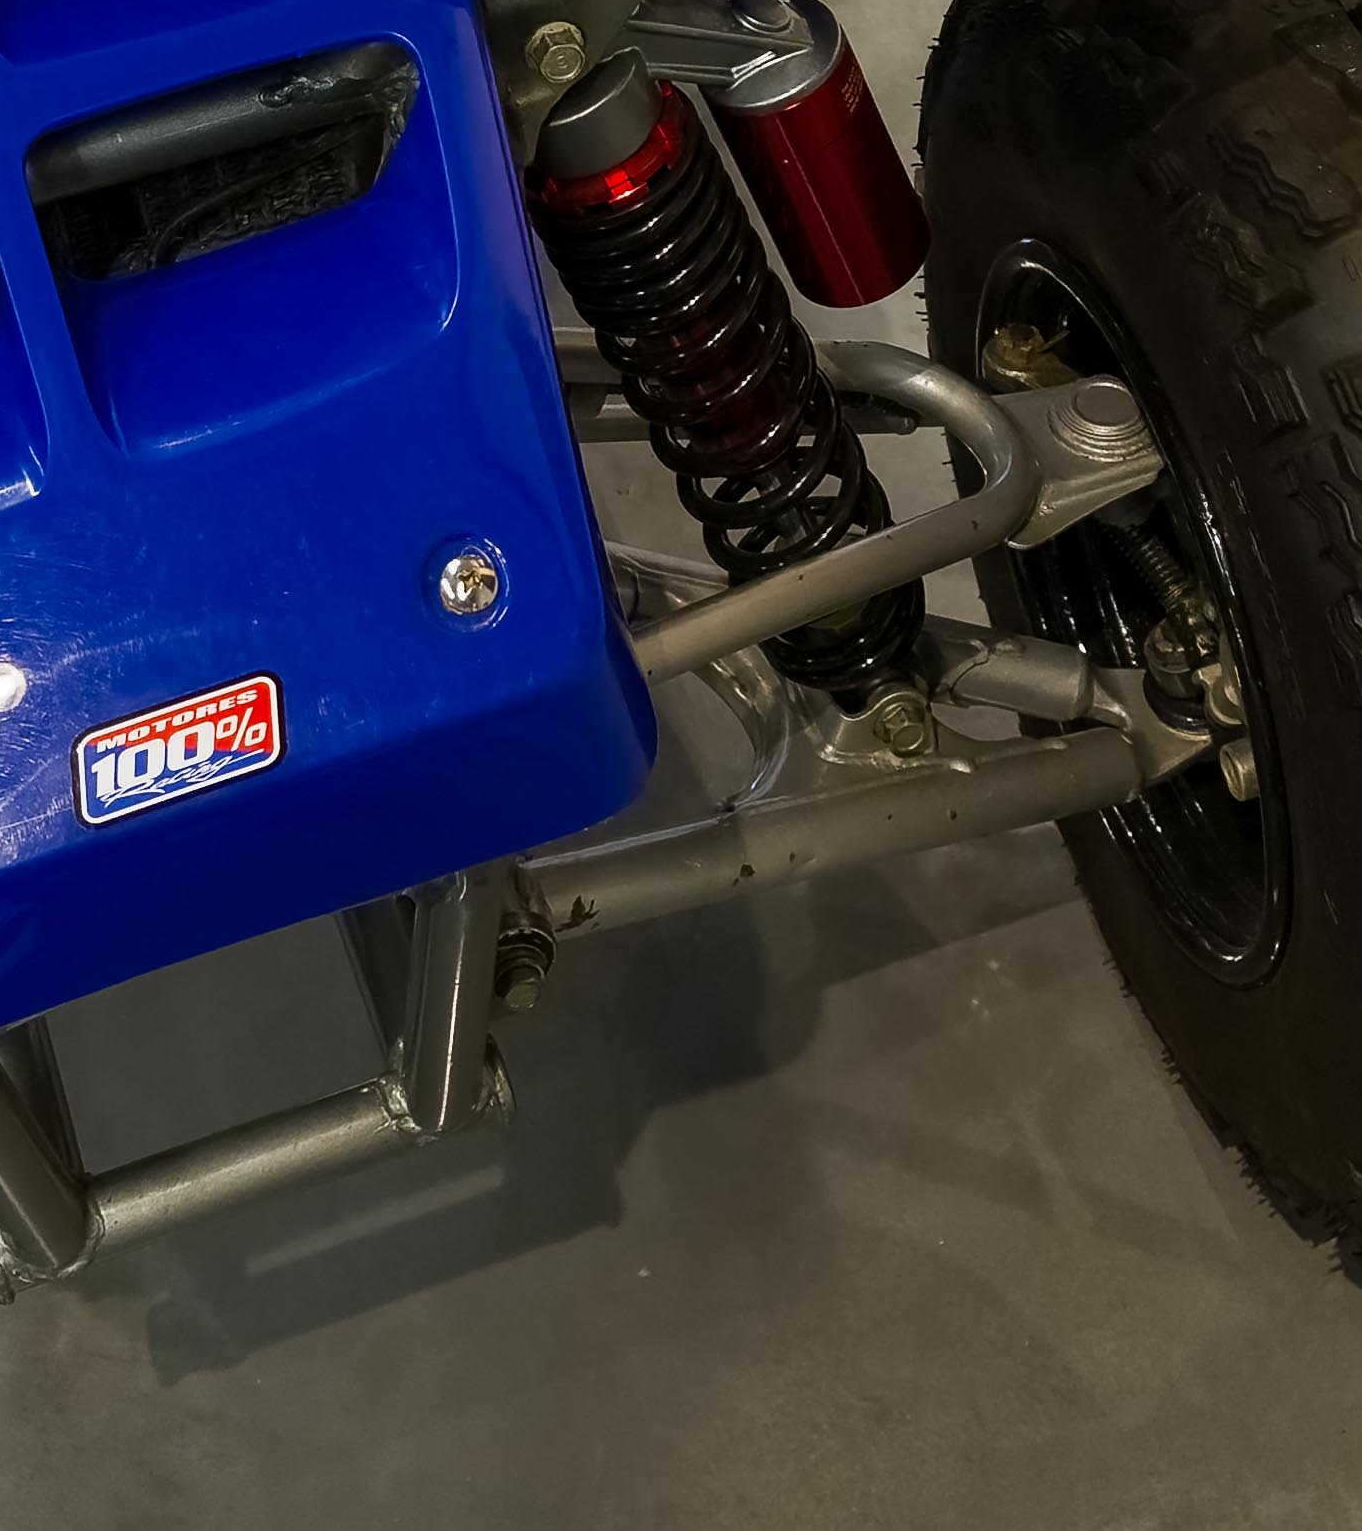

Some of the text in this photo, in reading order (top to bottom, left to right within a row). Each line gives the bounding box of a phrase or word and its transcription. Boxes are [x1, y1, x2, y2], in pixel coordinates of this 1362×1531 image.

[91, 706, 268, 799] 100%
[96, 688, 259, 754] MOTORES
[99, 748, 265, 809] Racing
